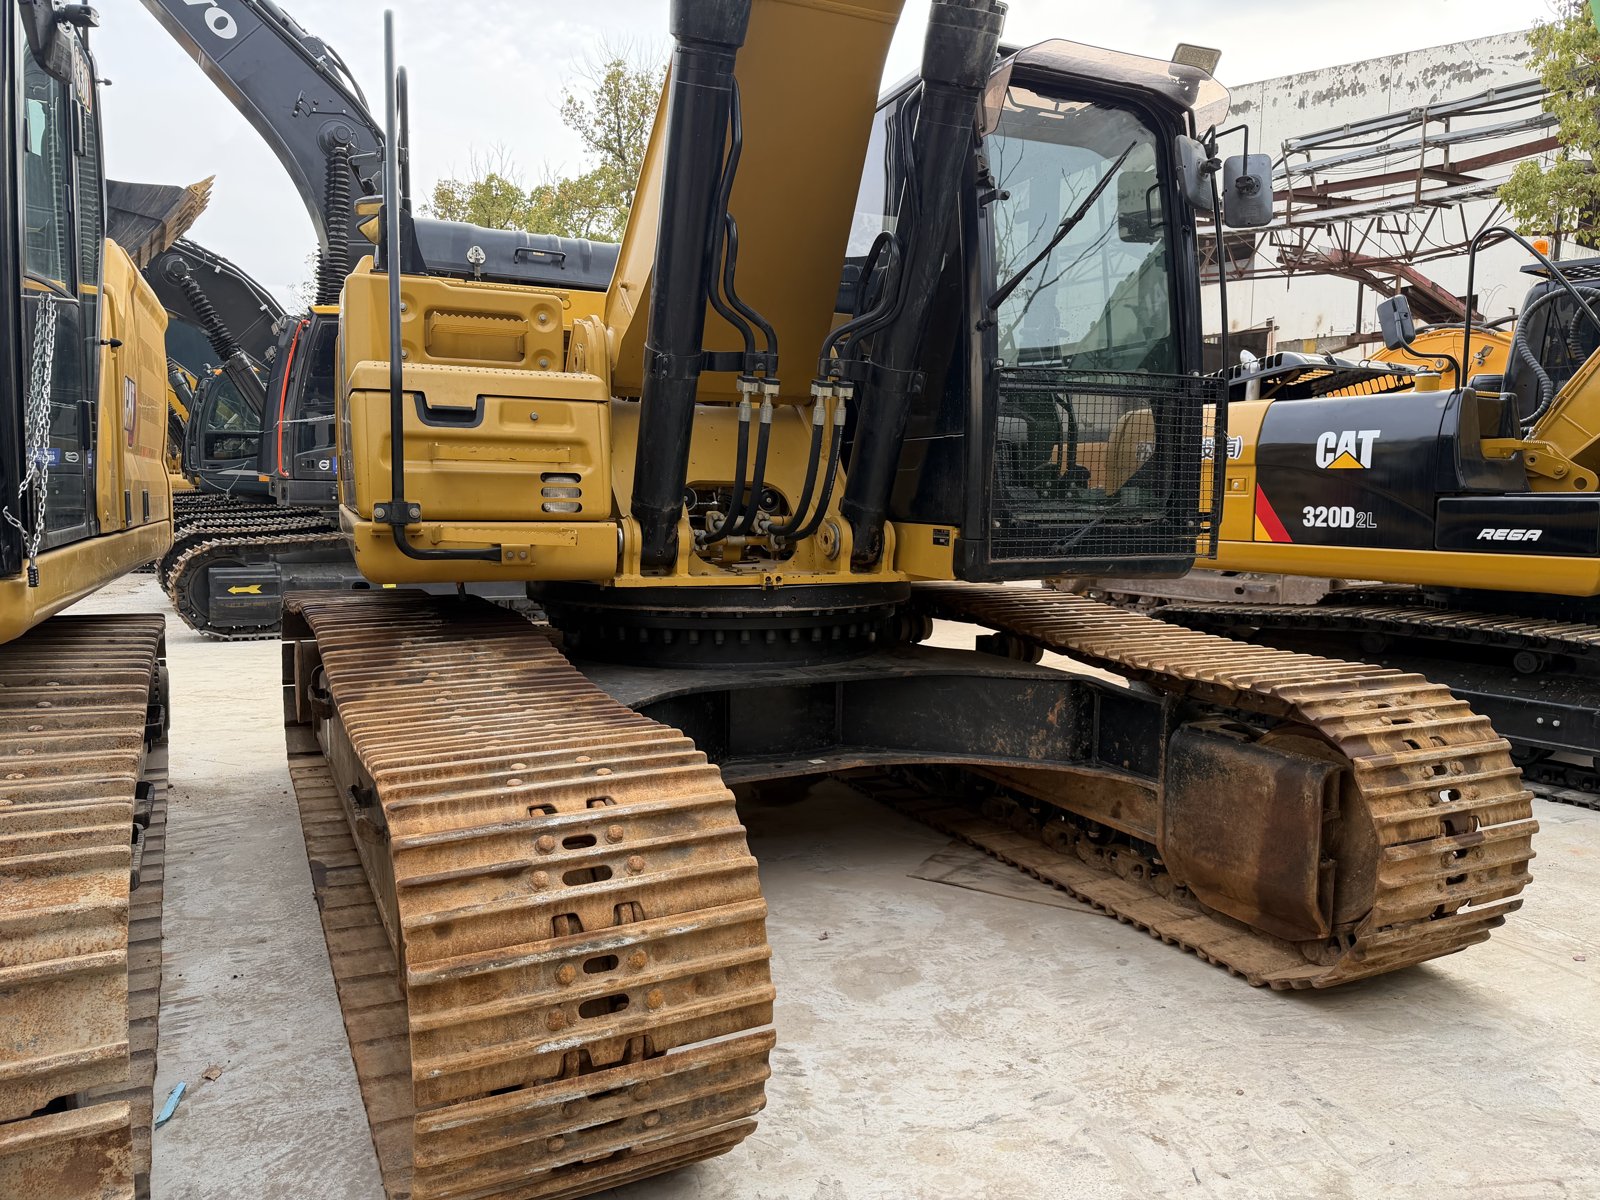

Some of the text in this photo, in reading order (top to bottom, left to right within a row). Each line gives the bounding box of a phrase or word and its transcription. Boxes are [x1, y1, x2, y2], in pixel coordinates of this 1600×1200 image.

[183, 0, 238, 39] O
[1315, 430, 1381, 469] CAT
[1302, 506, 1377, 529] 320D2L
[1476, 528, 1543, 541] REGA
